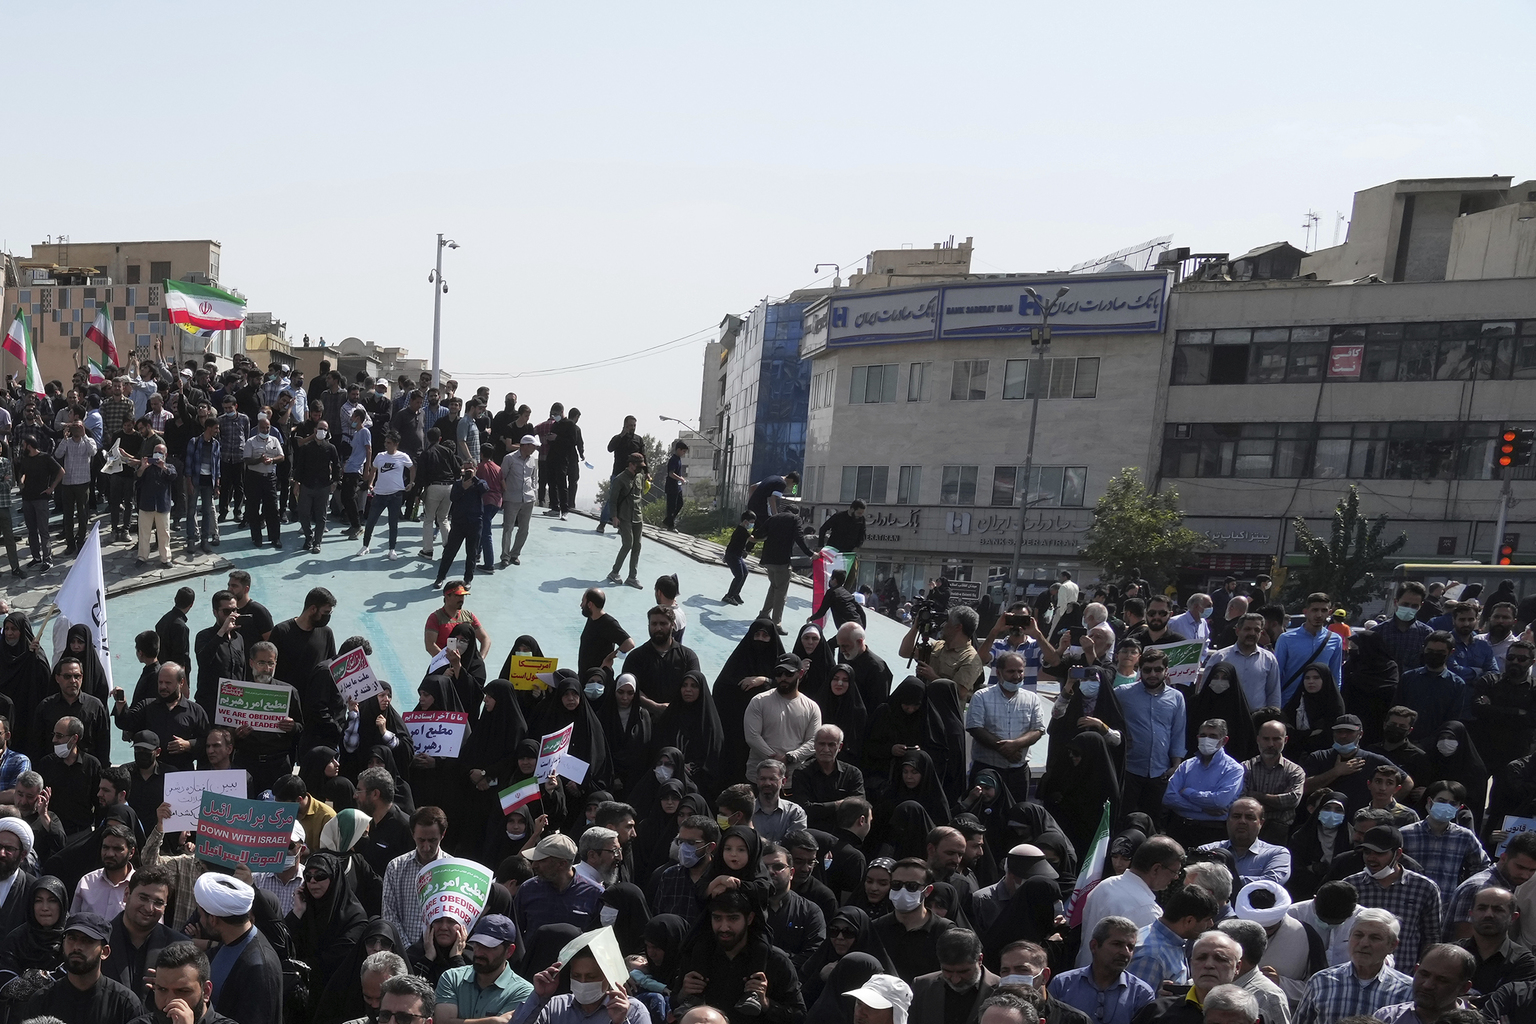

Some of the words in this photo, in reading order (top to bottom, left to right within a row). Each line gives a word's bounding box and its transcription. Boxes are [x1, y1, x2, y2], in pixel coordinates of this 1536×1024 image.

[1078, 297, 1127, 312] صادرات
[1127, 288, 1161, 314] بانک
[946, 306, 965, 315] BANK
[966, 305, 996, 314] SADERAT
[996, 304, 1014, 313] IRAN
[1332, 347, 1362, 360] کافی
[1332, 361, 1356, 372] نت
[897, 509, 922, 534] بانک
[976, 514, 1012, 535] ایران
[980, 538, 1007, 546] BANK
[218, 708, 231, 716] WE
[232, 711, 247, 719] ARE
[248, 713, 287, 722] OBEDIENT
[222, 716, 233, 724] TO
[234, 718, 249, 726] THE
[425, 724, 454, 739] مطیع
[250, 815, 266, 830] بر
[268, 808, 294, 829] مرگ
[200, 824, 230, 839] DOWN
[231, 832, 257, 844] WITH
[257, 836, 287, 844] ISRAEL
[459, 882, 485, 902] مطیع
[425, 897, 438, 912] ARE
[439, 895, 481, 918] OBEDIENT
[442, 904, 472, 926] LEADER
